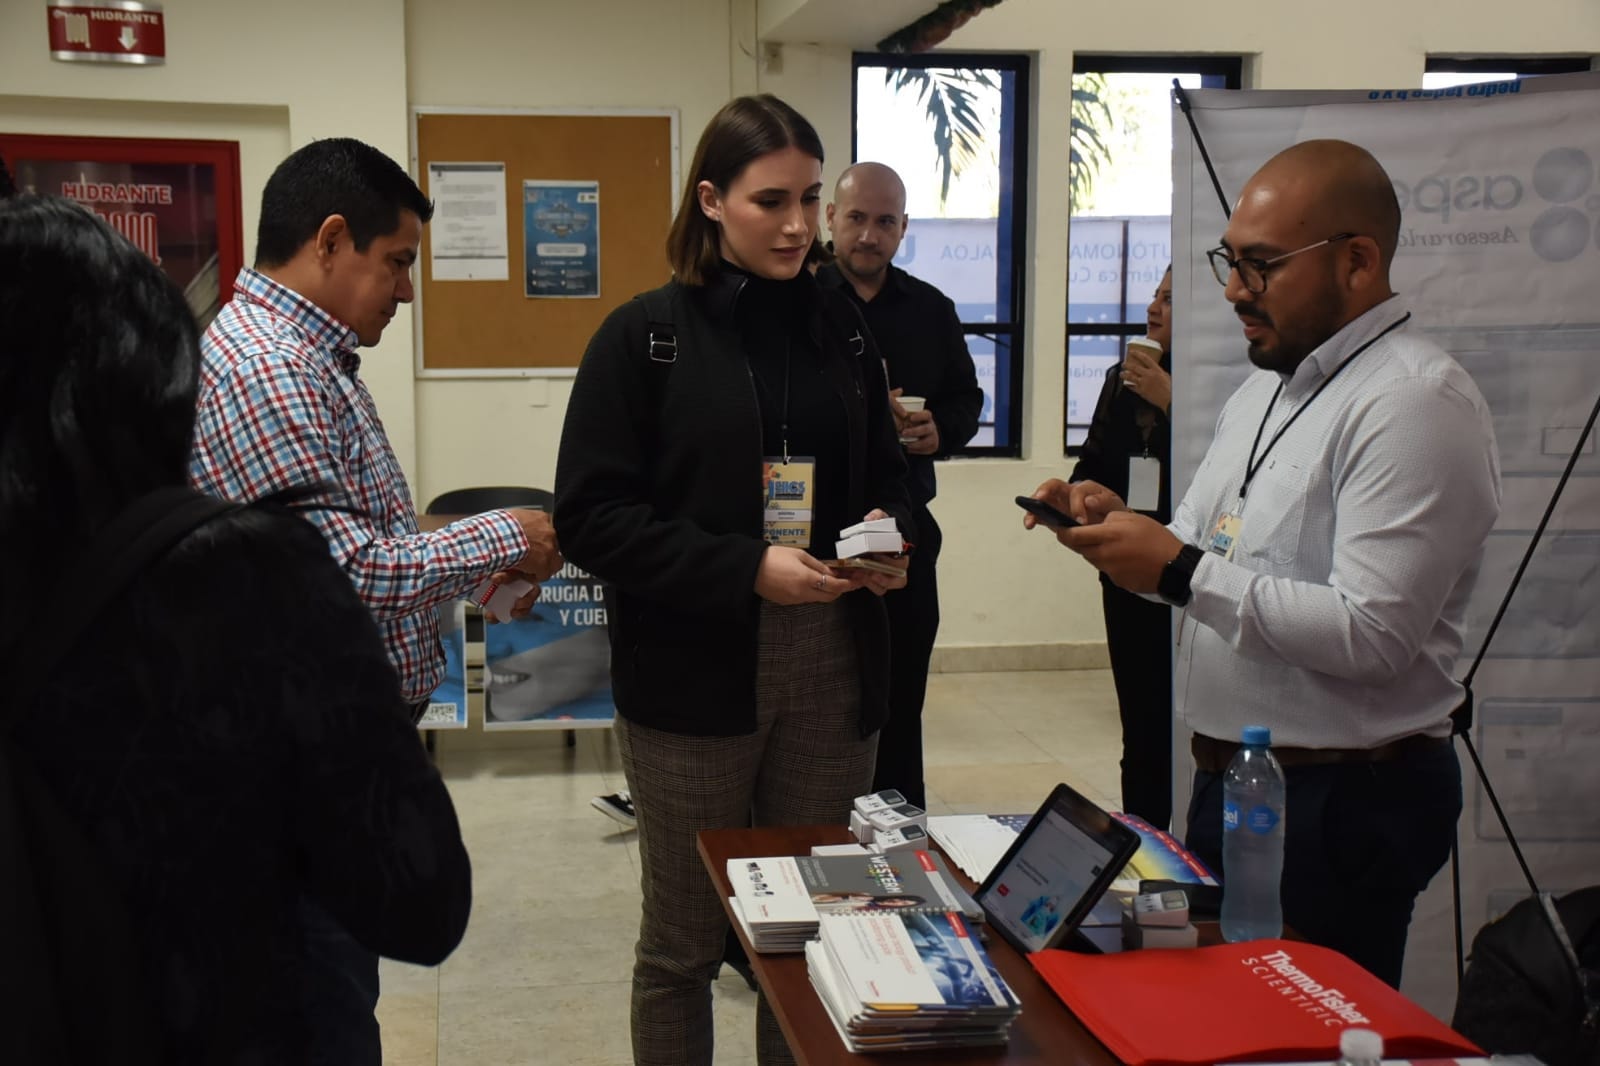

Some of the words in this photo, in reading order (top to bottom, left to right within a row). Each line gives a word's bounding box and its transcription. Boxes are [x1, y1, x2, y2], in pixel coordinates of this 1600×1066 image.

[91, 11, 158, 24] HIDRANTE
[61, 182, 172, 204] HIDRANTE
[559, 608, 570, 627] Y
[1241, 957, 1344, 1027] SCIENTIFIC
